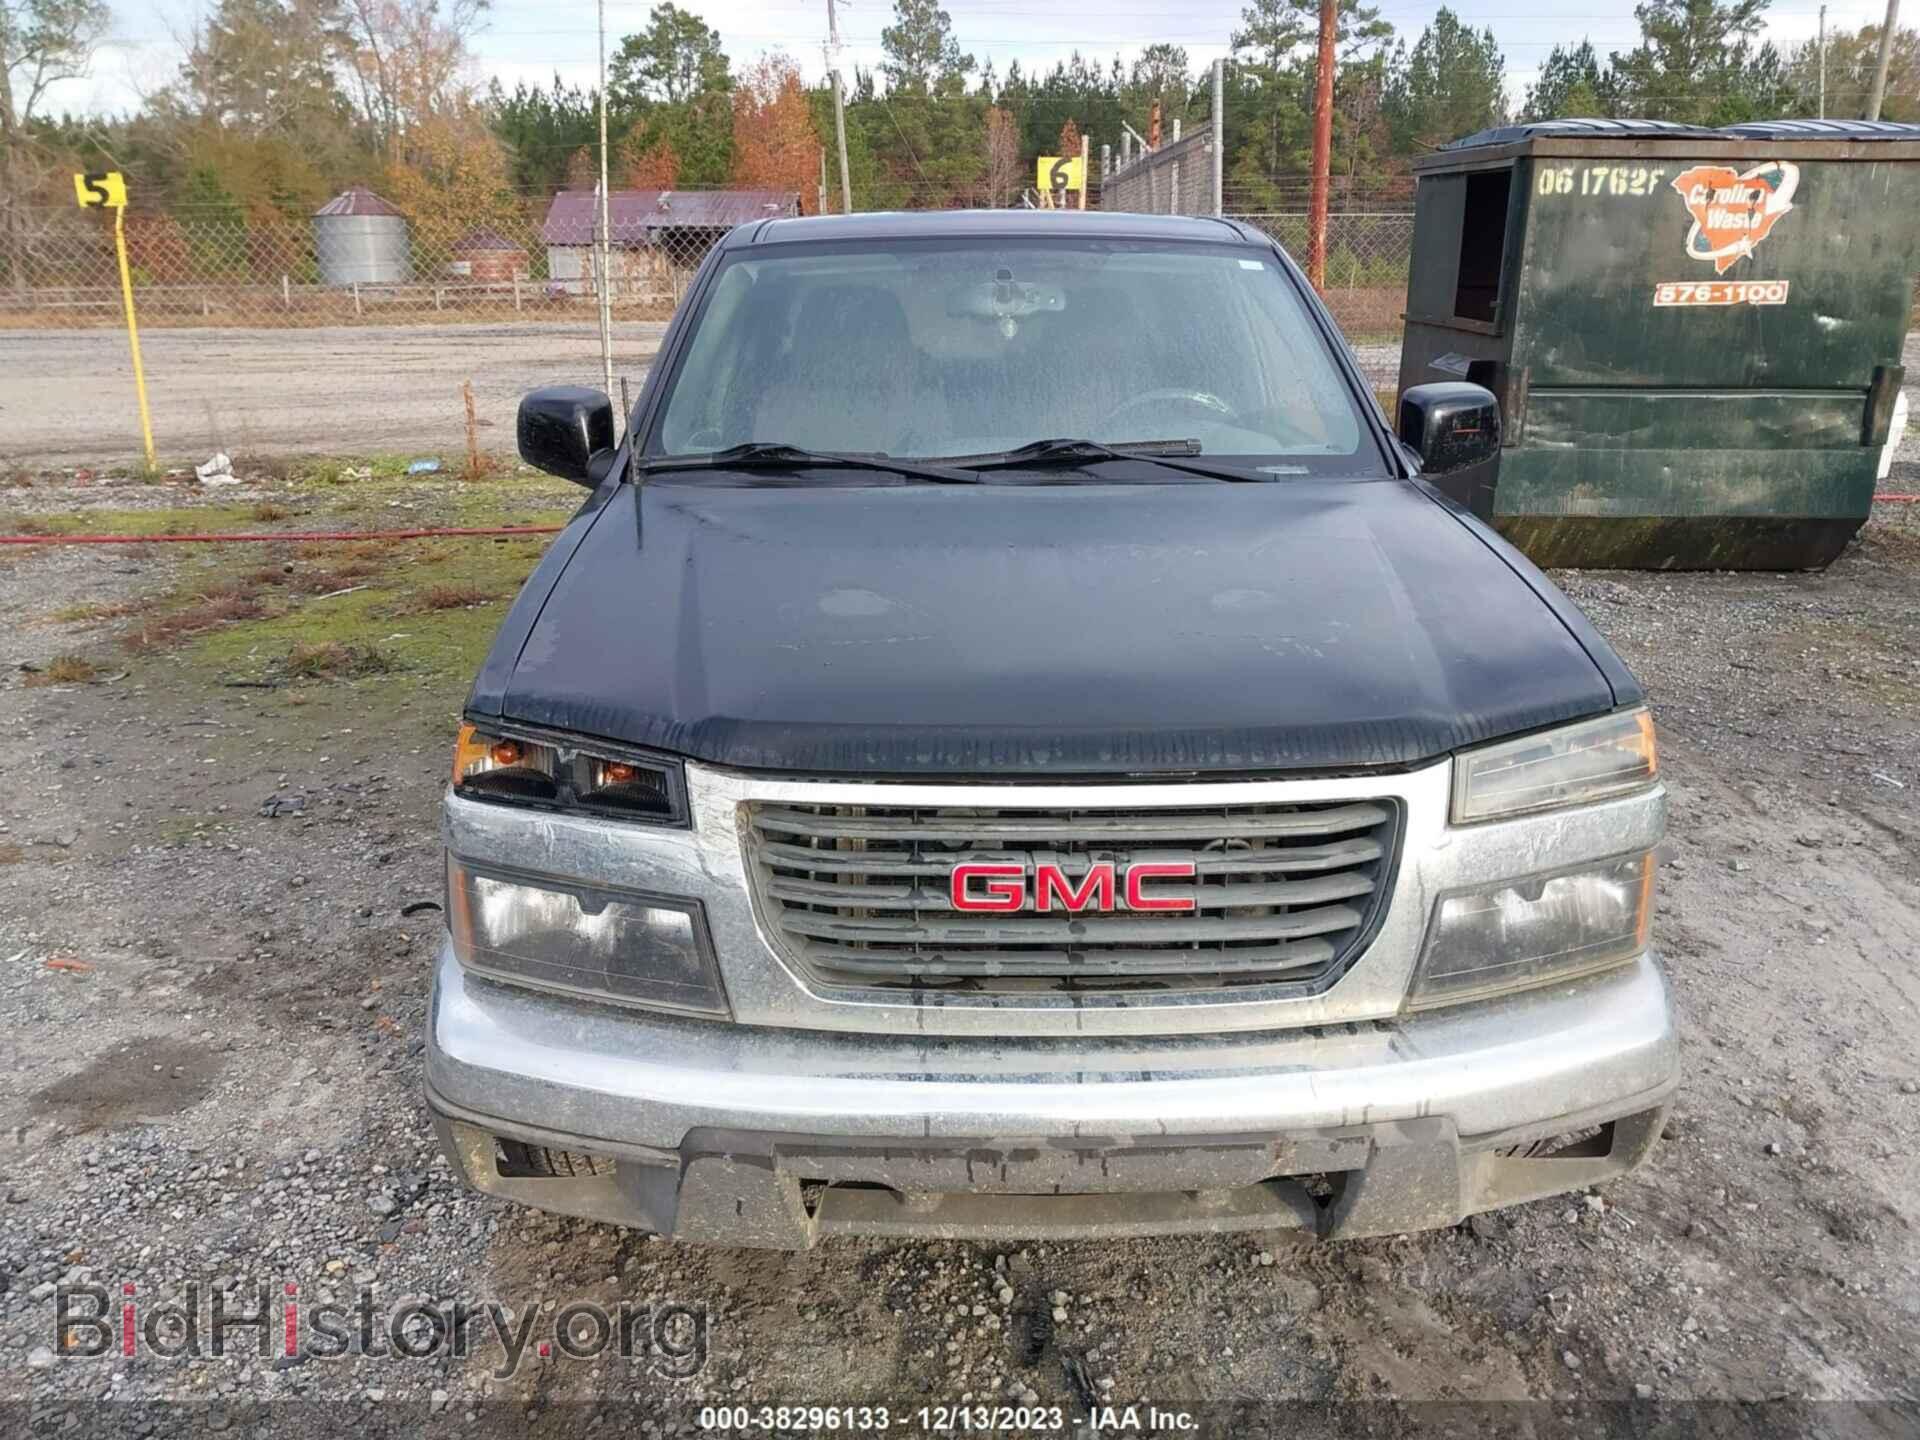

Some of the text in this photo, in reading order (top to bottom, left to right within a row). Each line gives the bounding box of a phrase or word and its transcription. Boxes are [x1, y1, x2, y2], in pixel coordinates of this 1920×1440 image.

[1050, 157, 1073, 190] 6
[84, 173, 109, 208] 5
[1707, 208, 1763, 229] Waste
[1660, 284, 1784, 302] 576-1100
[951, 863, 1196, 912] GMC
